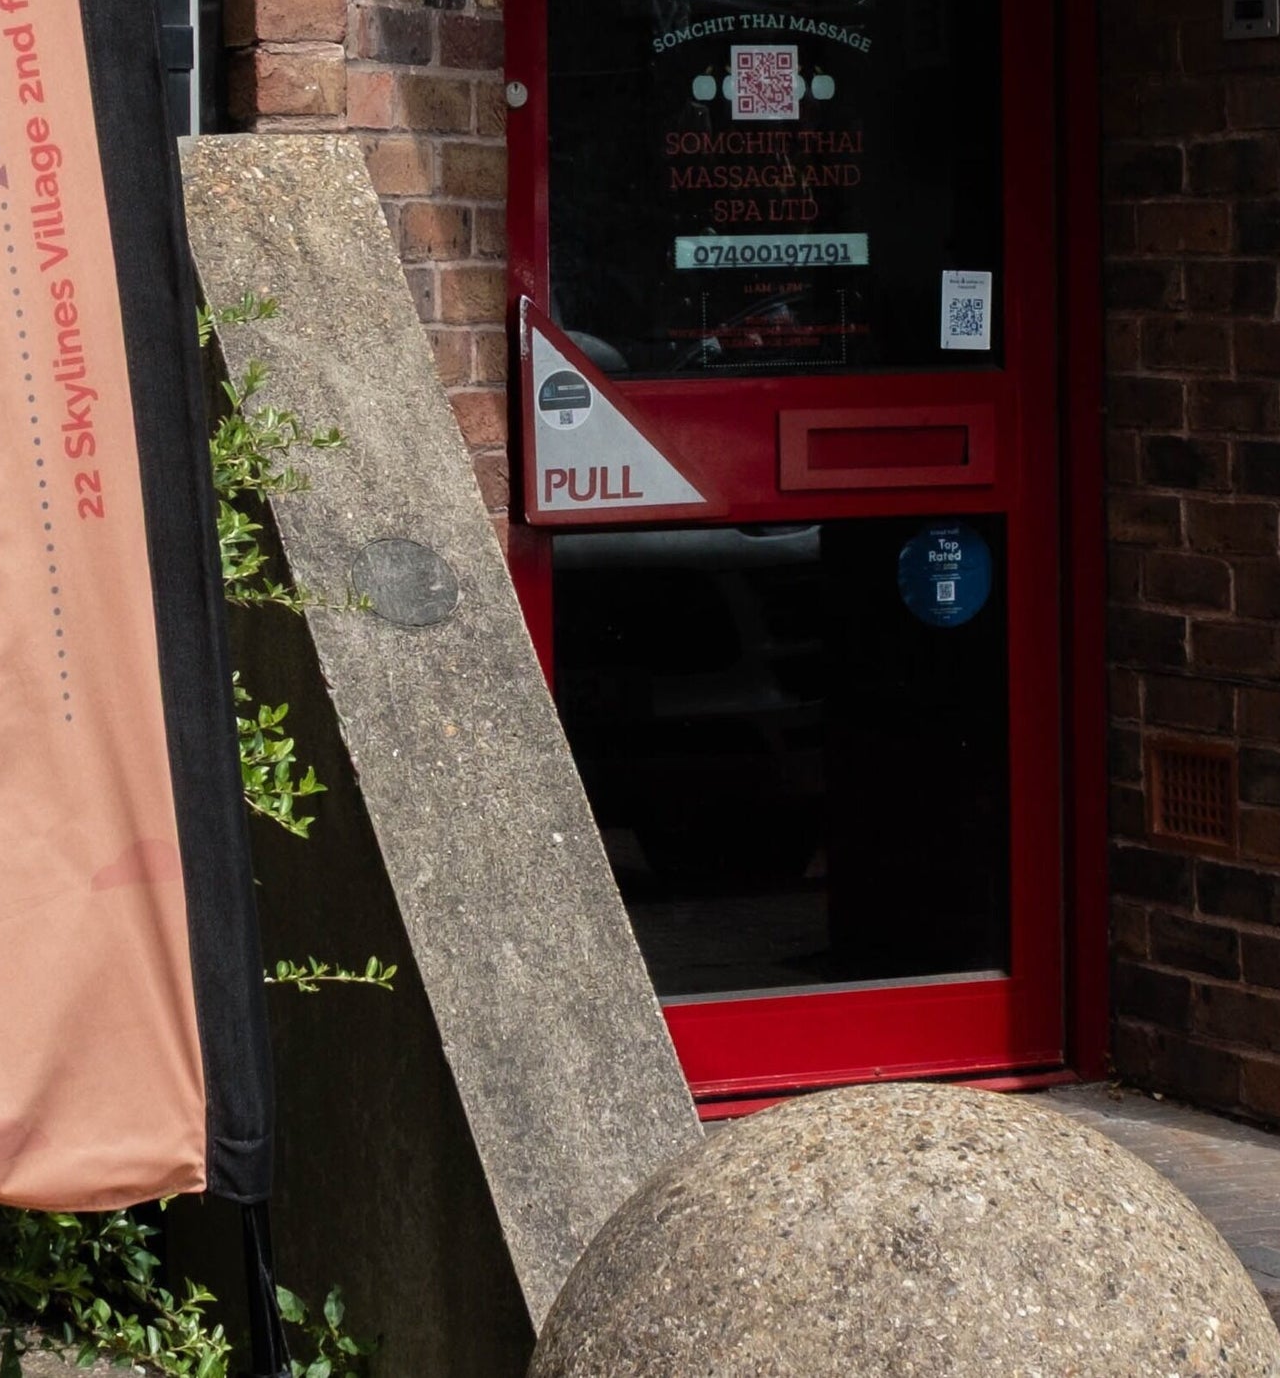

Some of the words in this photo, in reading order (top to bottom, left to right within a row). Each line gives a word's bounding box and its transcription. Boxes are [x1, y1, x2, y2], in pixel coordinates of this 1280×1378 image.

[652, 16, 735, 53] SOMCHIT
[740, 14, 784, 29] THAI
[790, 15, 872, 53] MASSAGE
[2, 23, 45, 105] 2nd
[666, 131, 794, 155] SOMCHIT
[800, 130, 863, 154] THAI
[670, 165, 795, 190] MASSAGE
[803, 164, 861, 188] AND
[26, 115, 70, 272] Village
[714, 200, 761, 222] SPA
[770, 198, 819, 221] LTD
[693, 243, 852, 267] 07400197191
[49, 279, 100, 458] Skylines
[74, 470, 105, 519] 22
[544, 465, 643, 503] PULL
[928, 550, 962, 562] Rated
[938, 539, 959, 552] Top
